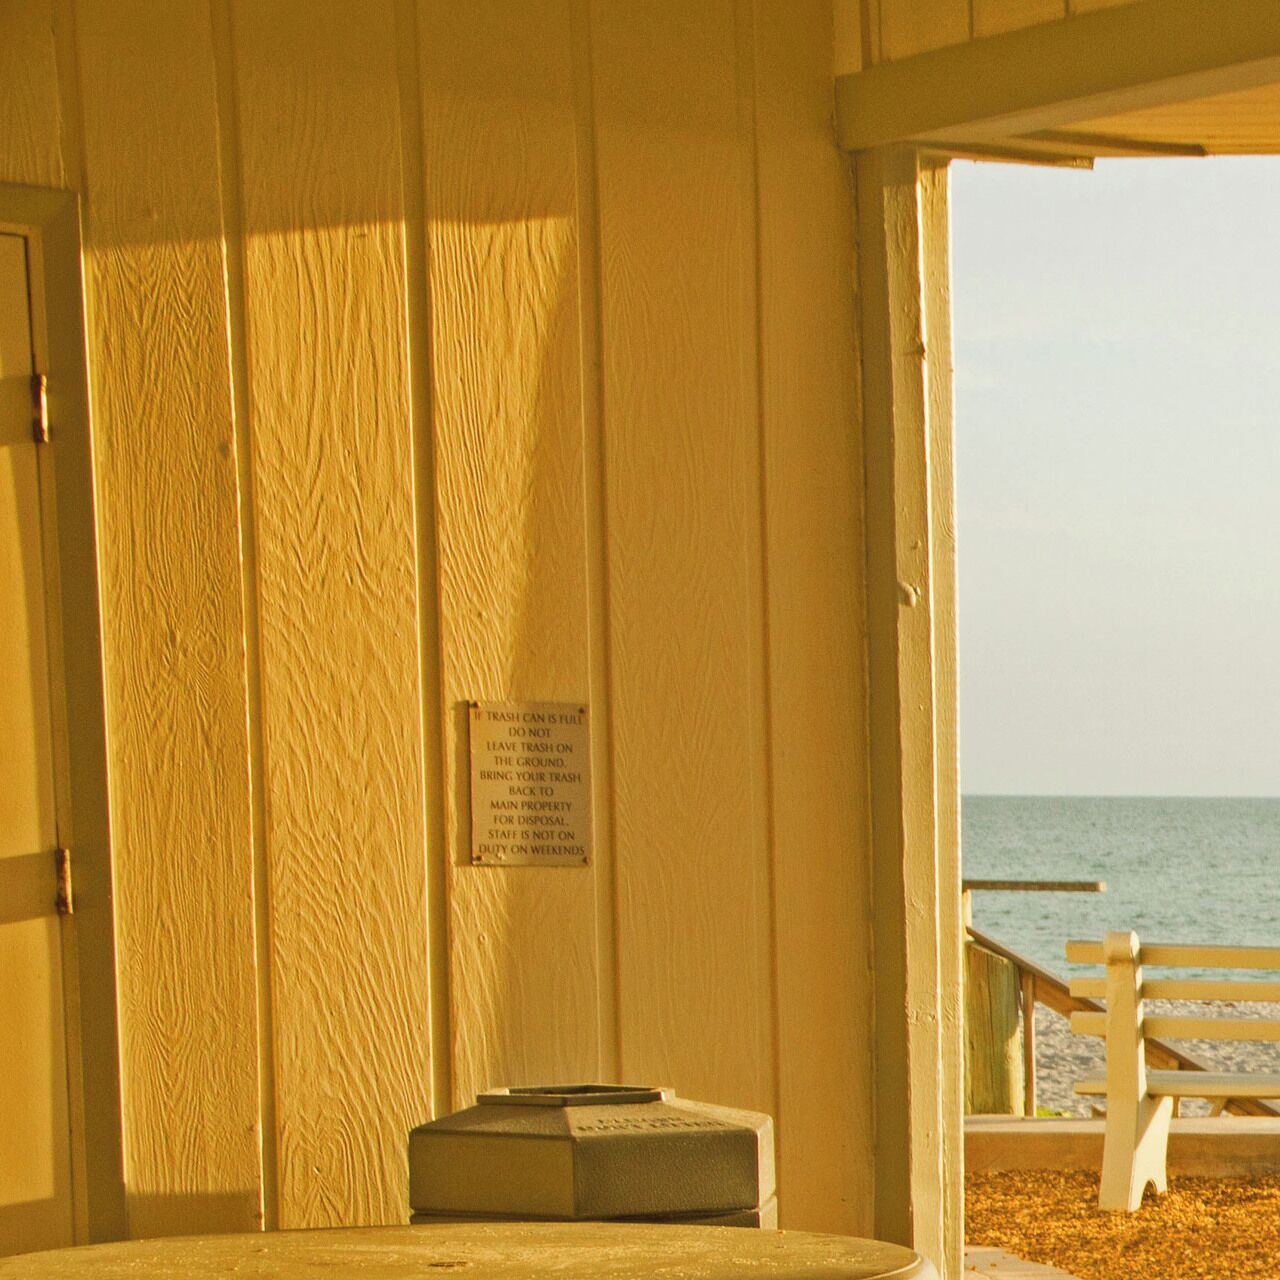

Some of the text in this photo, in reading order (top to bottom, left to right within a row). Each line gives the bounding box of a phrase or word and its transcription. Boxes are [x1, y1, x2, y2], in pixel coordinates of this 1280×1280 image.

[487, 712, 520, 723] TRASH
[523, 713, 544, 723] CAN
[549, 714, 557, 723] IS
[560, 714, 582, 725] FULL
[509, 728, 550, 737] DO NOT
[487, 742, 573, 752] LEAVE TRASH ON
[495, 756, 566, 768] THE GROUND.
[480, 771, 581, 782] BRING YOUR TRASH
[509, 786, 554, 796] BACK TO
[491, 801, 572, 811] MAIN PROPERTY
[494, 815, 514, 824] FOR
[489, 830, 575, 840] STAFF IS NOT ON
[479, 844, 585, 856] DUTY ON WEEKENDS
